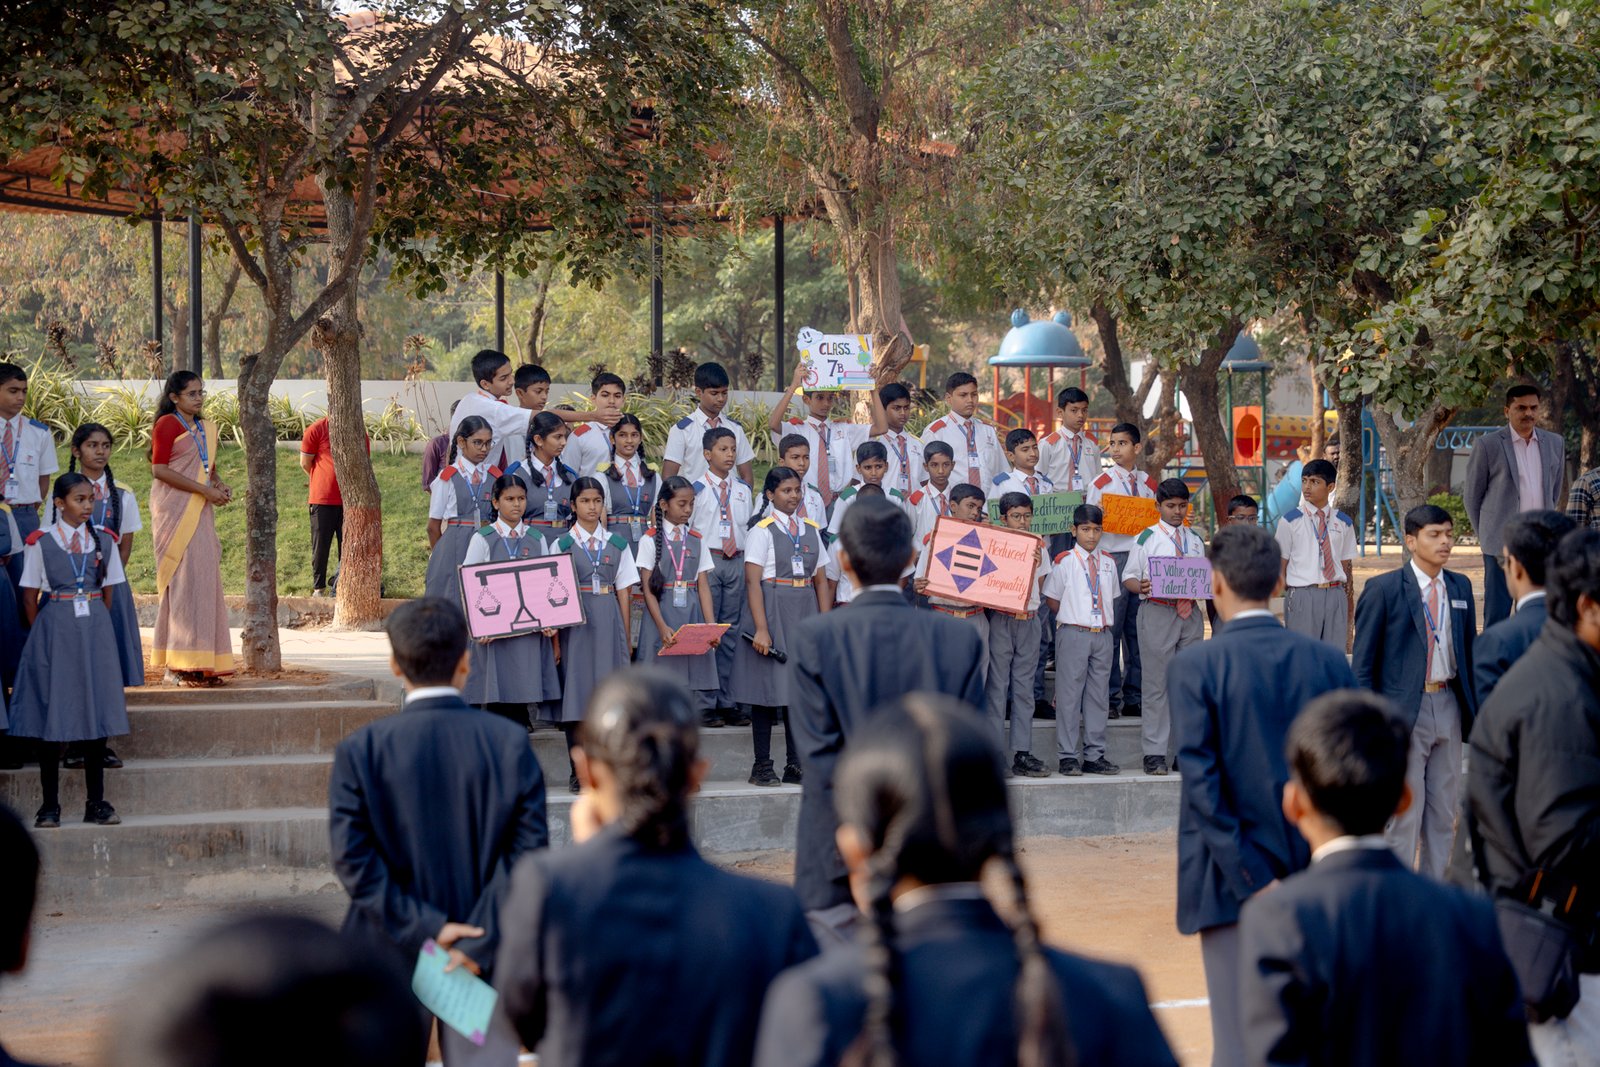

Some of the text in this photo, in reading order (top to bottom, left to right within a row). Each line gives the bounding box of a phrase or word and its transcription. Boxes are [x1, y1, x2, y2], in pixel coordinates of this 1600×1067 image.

[987, 539, 1029, 561] Reduced
[1152, 561, 1207, 584] I value every
[985, 574, 1027, 600] Inequality
